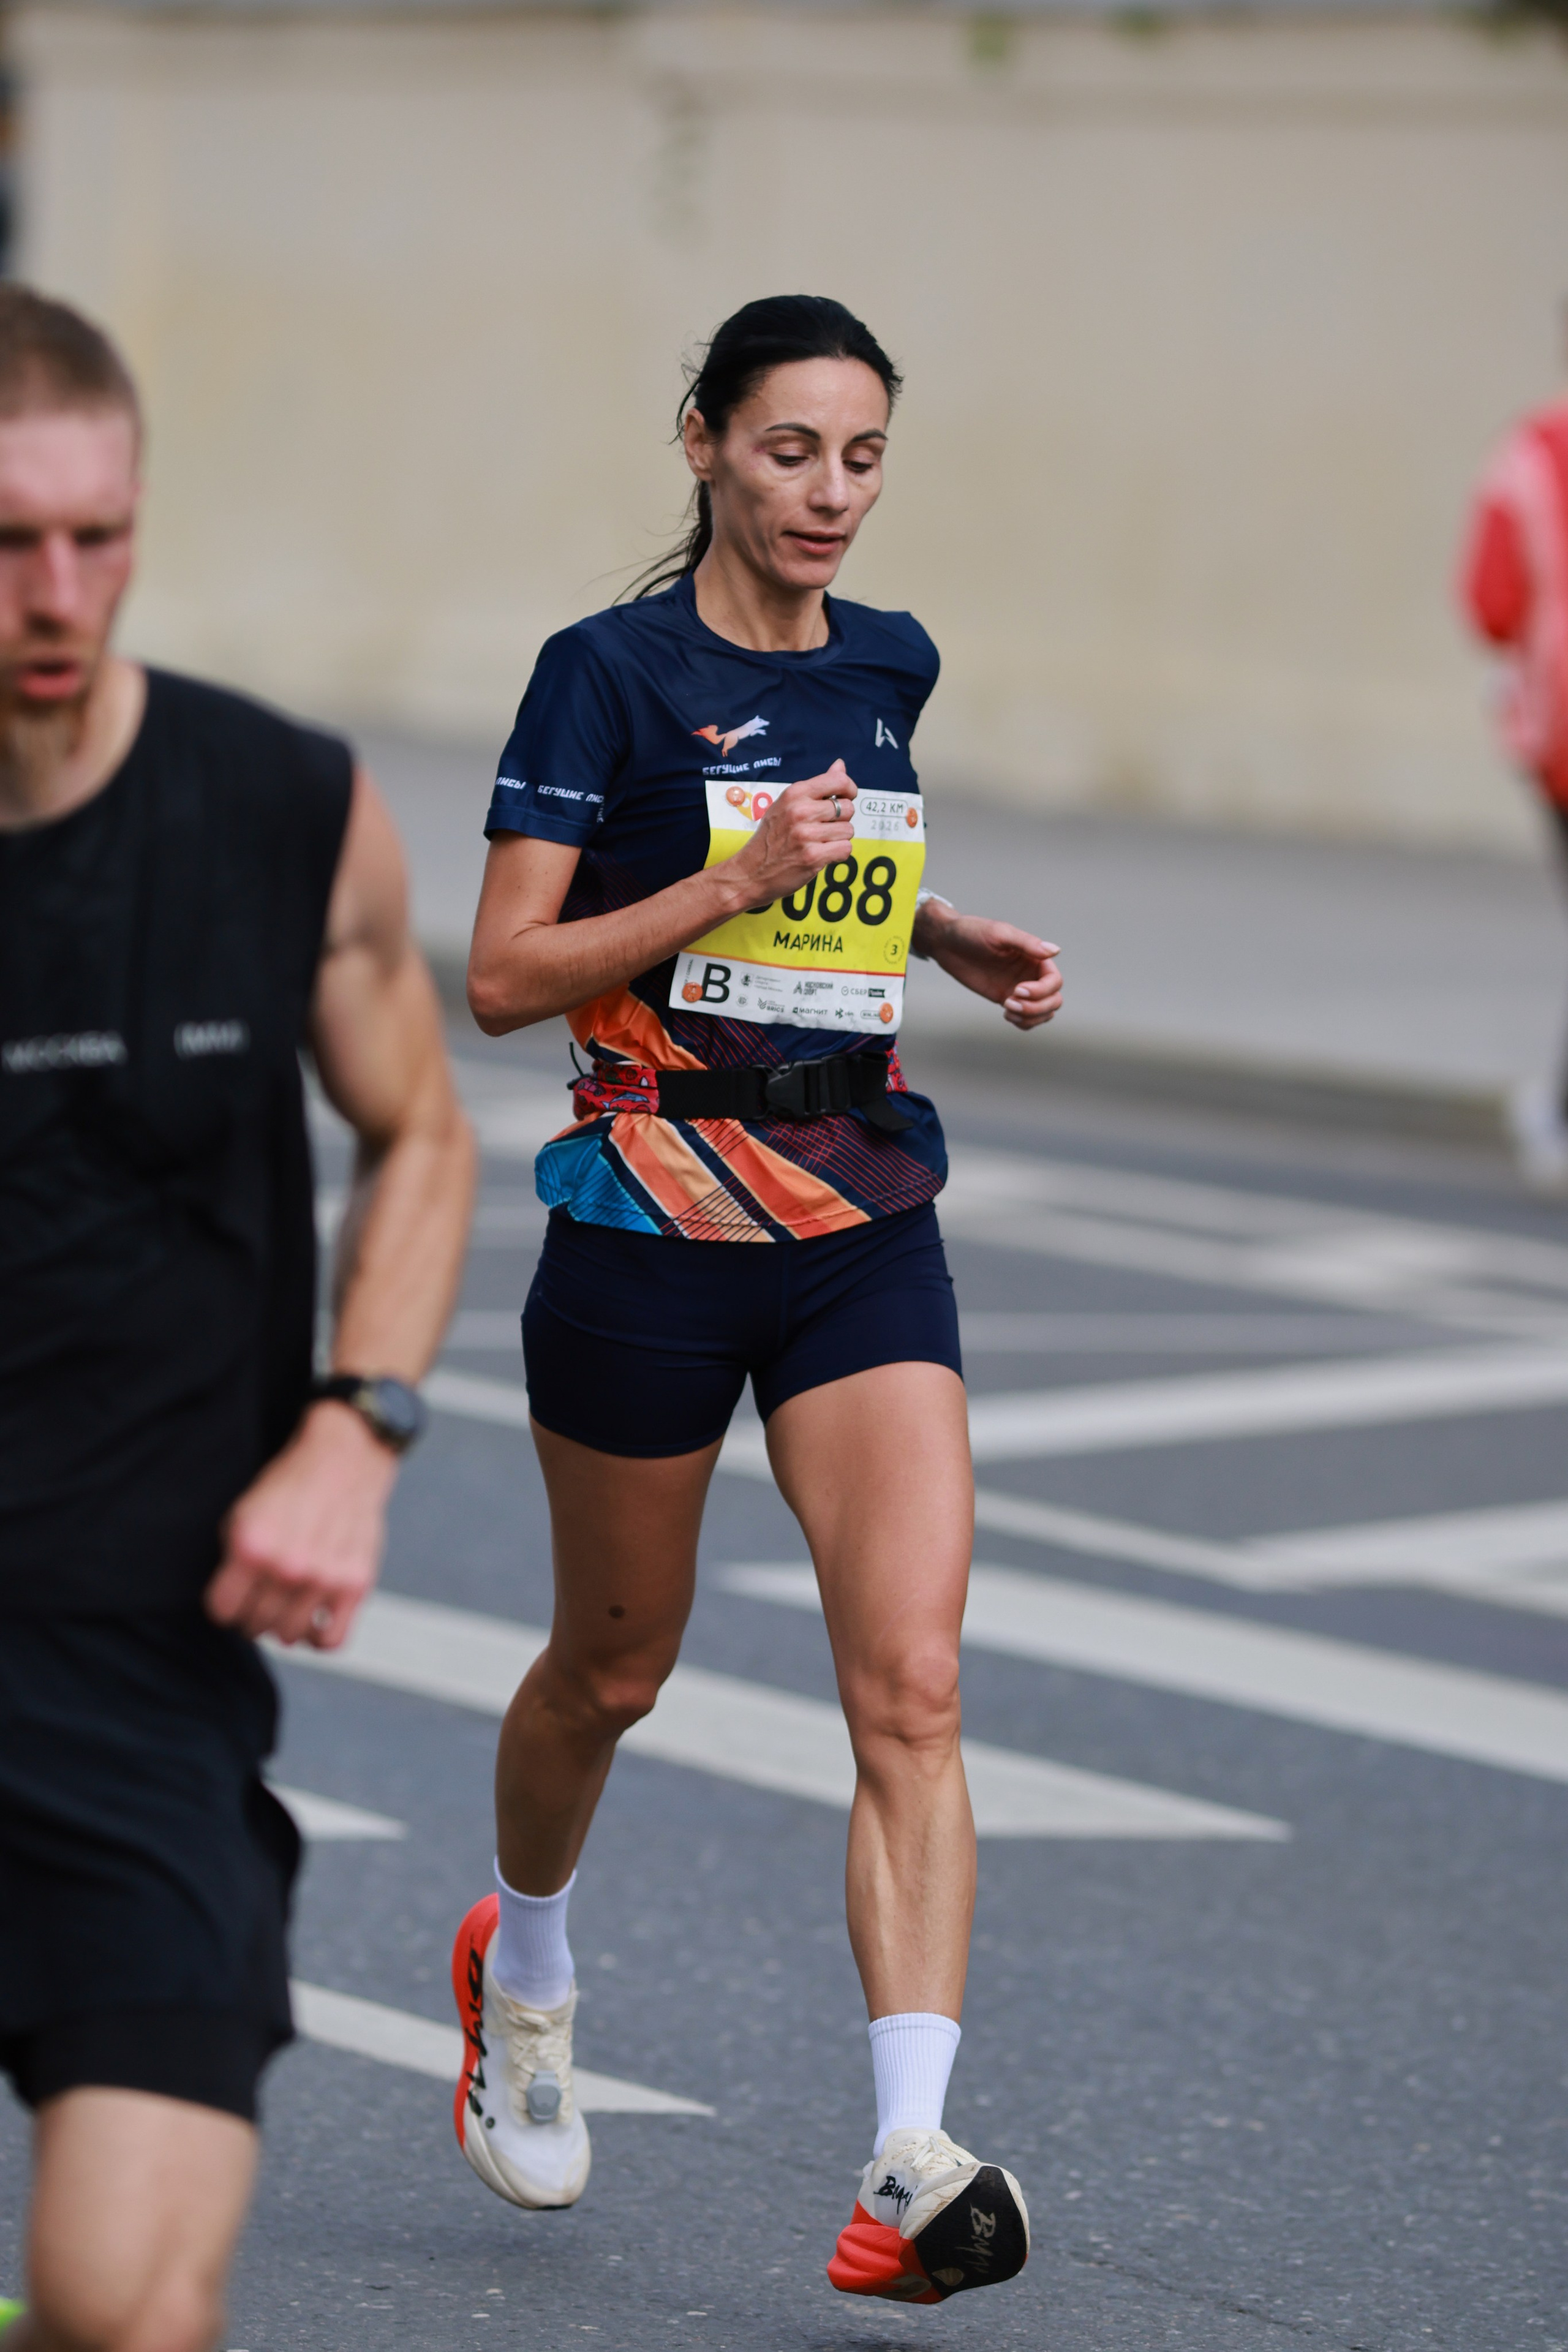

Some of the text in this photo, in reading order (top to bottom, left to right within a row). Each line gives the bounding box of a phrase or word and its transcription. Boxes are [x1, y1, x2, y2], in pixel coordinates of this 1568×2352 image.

[702, 757, 782, 775] БЕГУЩИЕ ЛИСЫ
[496, 777, 527, 790] ЛИСЫ
[537, 785, 605, 804] БЕГУЩИЕ ЛИС
[866, 801, 886, 814] 42,2
[744, 854, 897, 925] 088
[773, 930, 843, 952] МАРИНА
[890, 944, 898, 956] 3
[699, 962, 731, 1003] B
